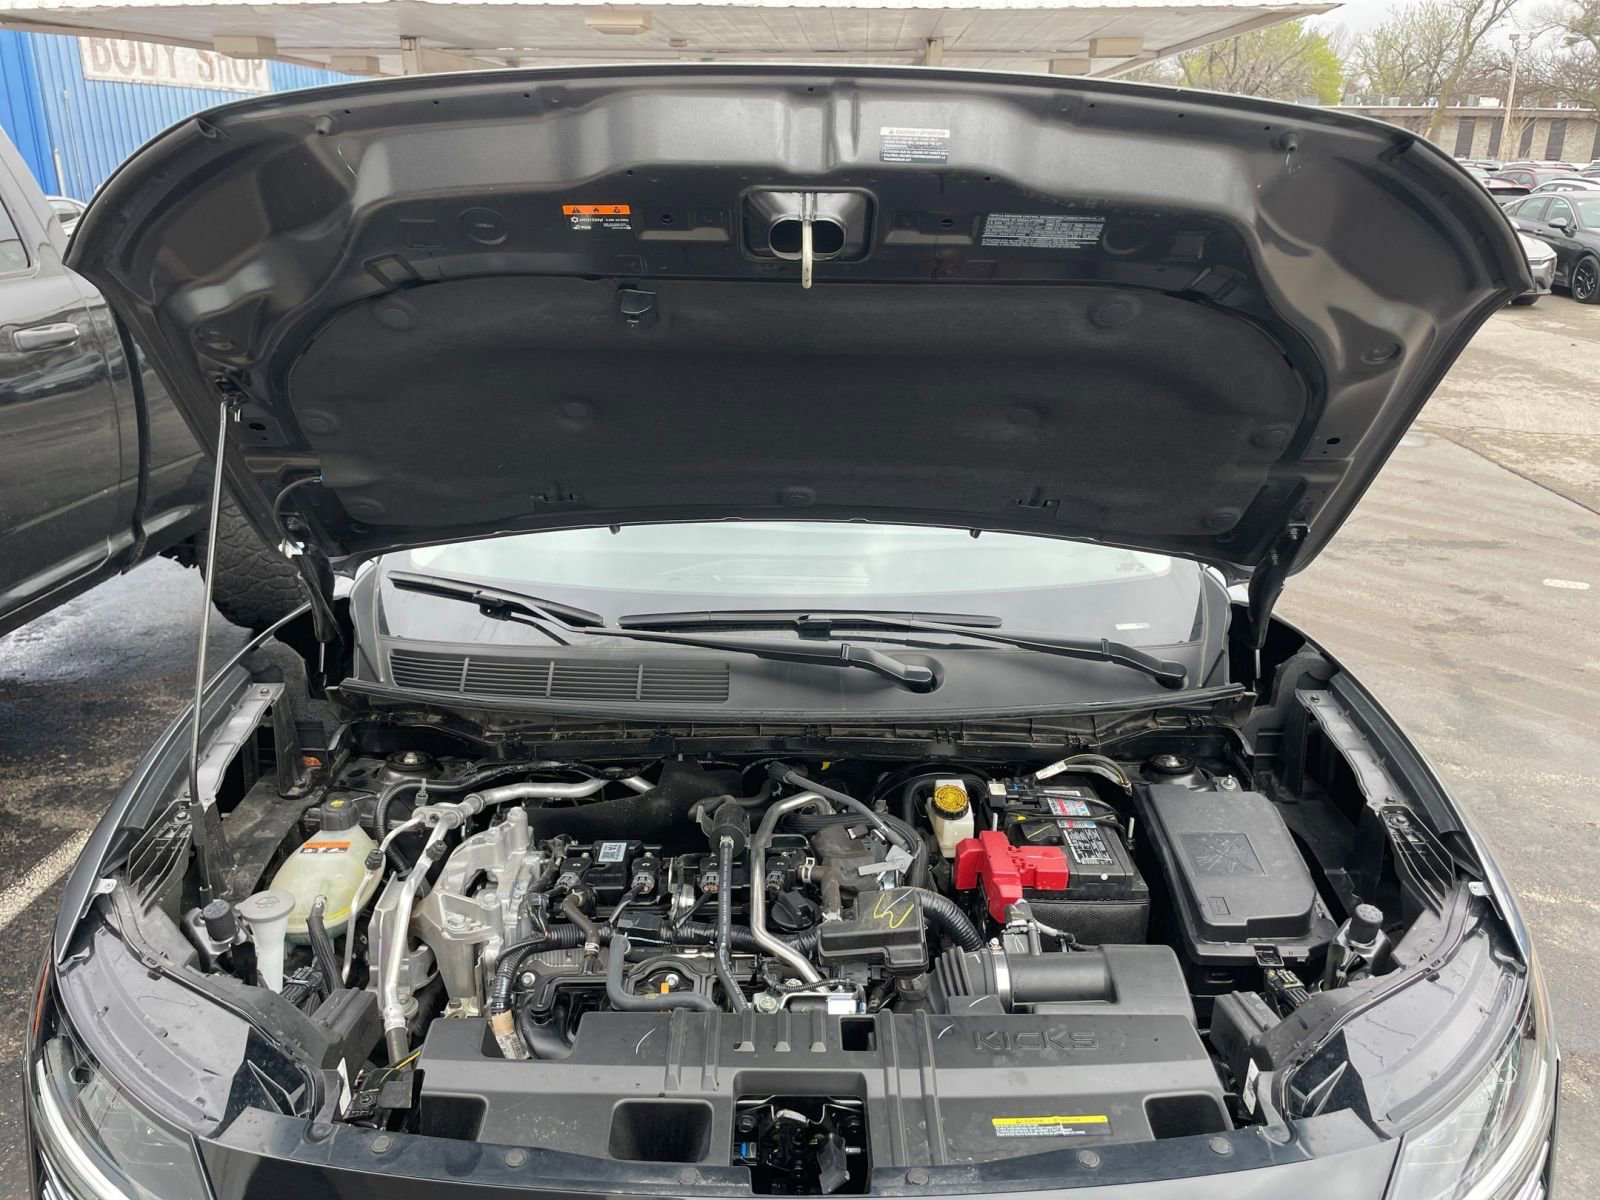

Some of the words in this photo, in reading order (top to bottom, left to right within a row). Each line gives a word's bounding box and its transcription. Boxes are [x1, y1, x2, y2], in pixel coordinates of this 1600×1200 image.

[89, 37, 176, 78] BODY
[197, 50, 264, 87] SHOP
[973, 1030, 1100, 1050] KICKS
